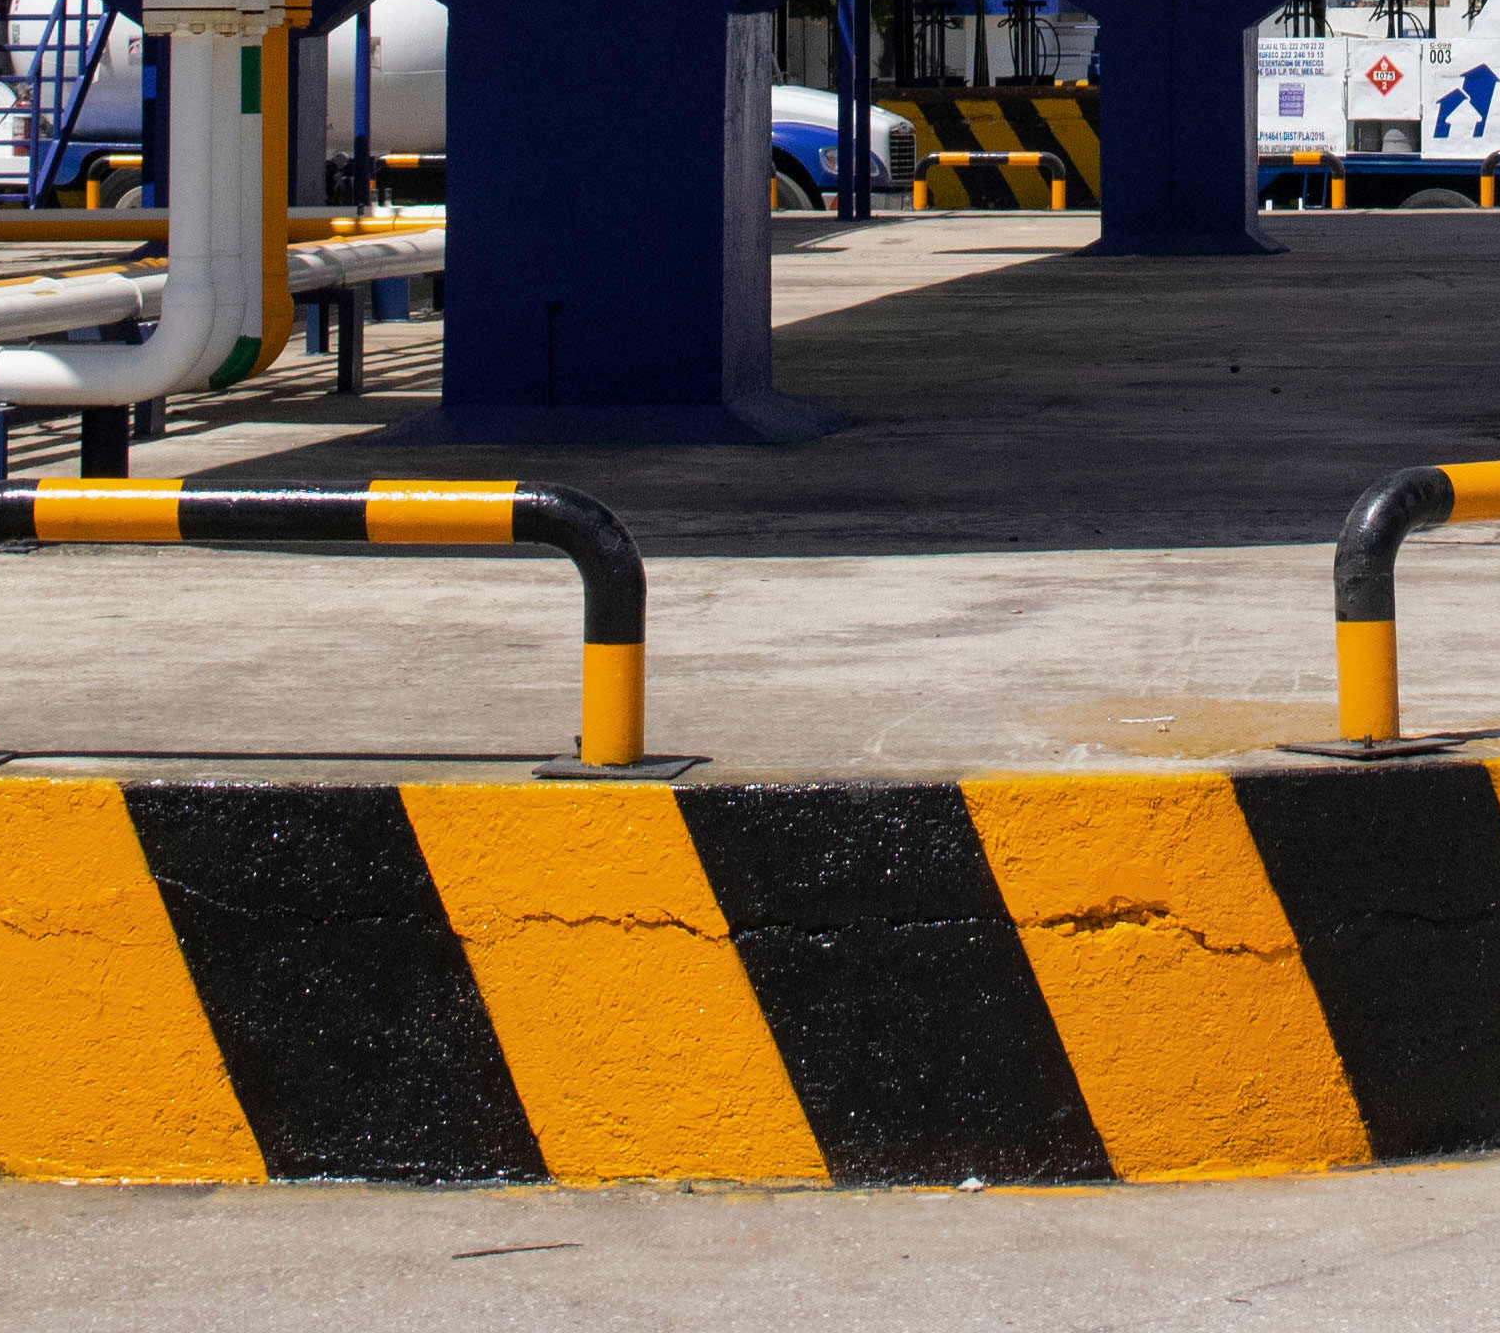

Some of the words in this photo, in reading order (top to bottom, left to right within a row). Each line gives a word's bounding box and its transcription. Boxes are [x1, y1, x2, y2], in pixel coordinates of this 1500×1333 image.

[1430, 50, 1451, 64] 003
[1264, 68, 1277, 76] GAS
[1375, 72, 1394, 80] 1075
[1382, 82, 1388, 90] 2
